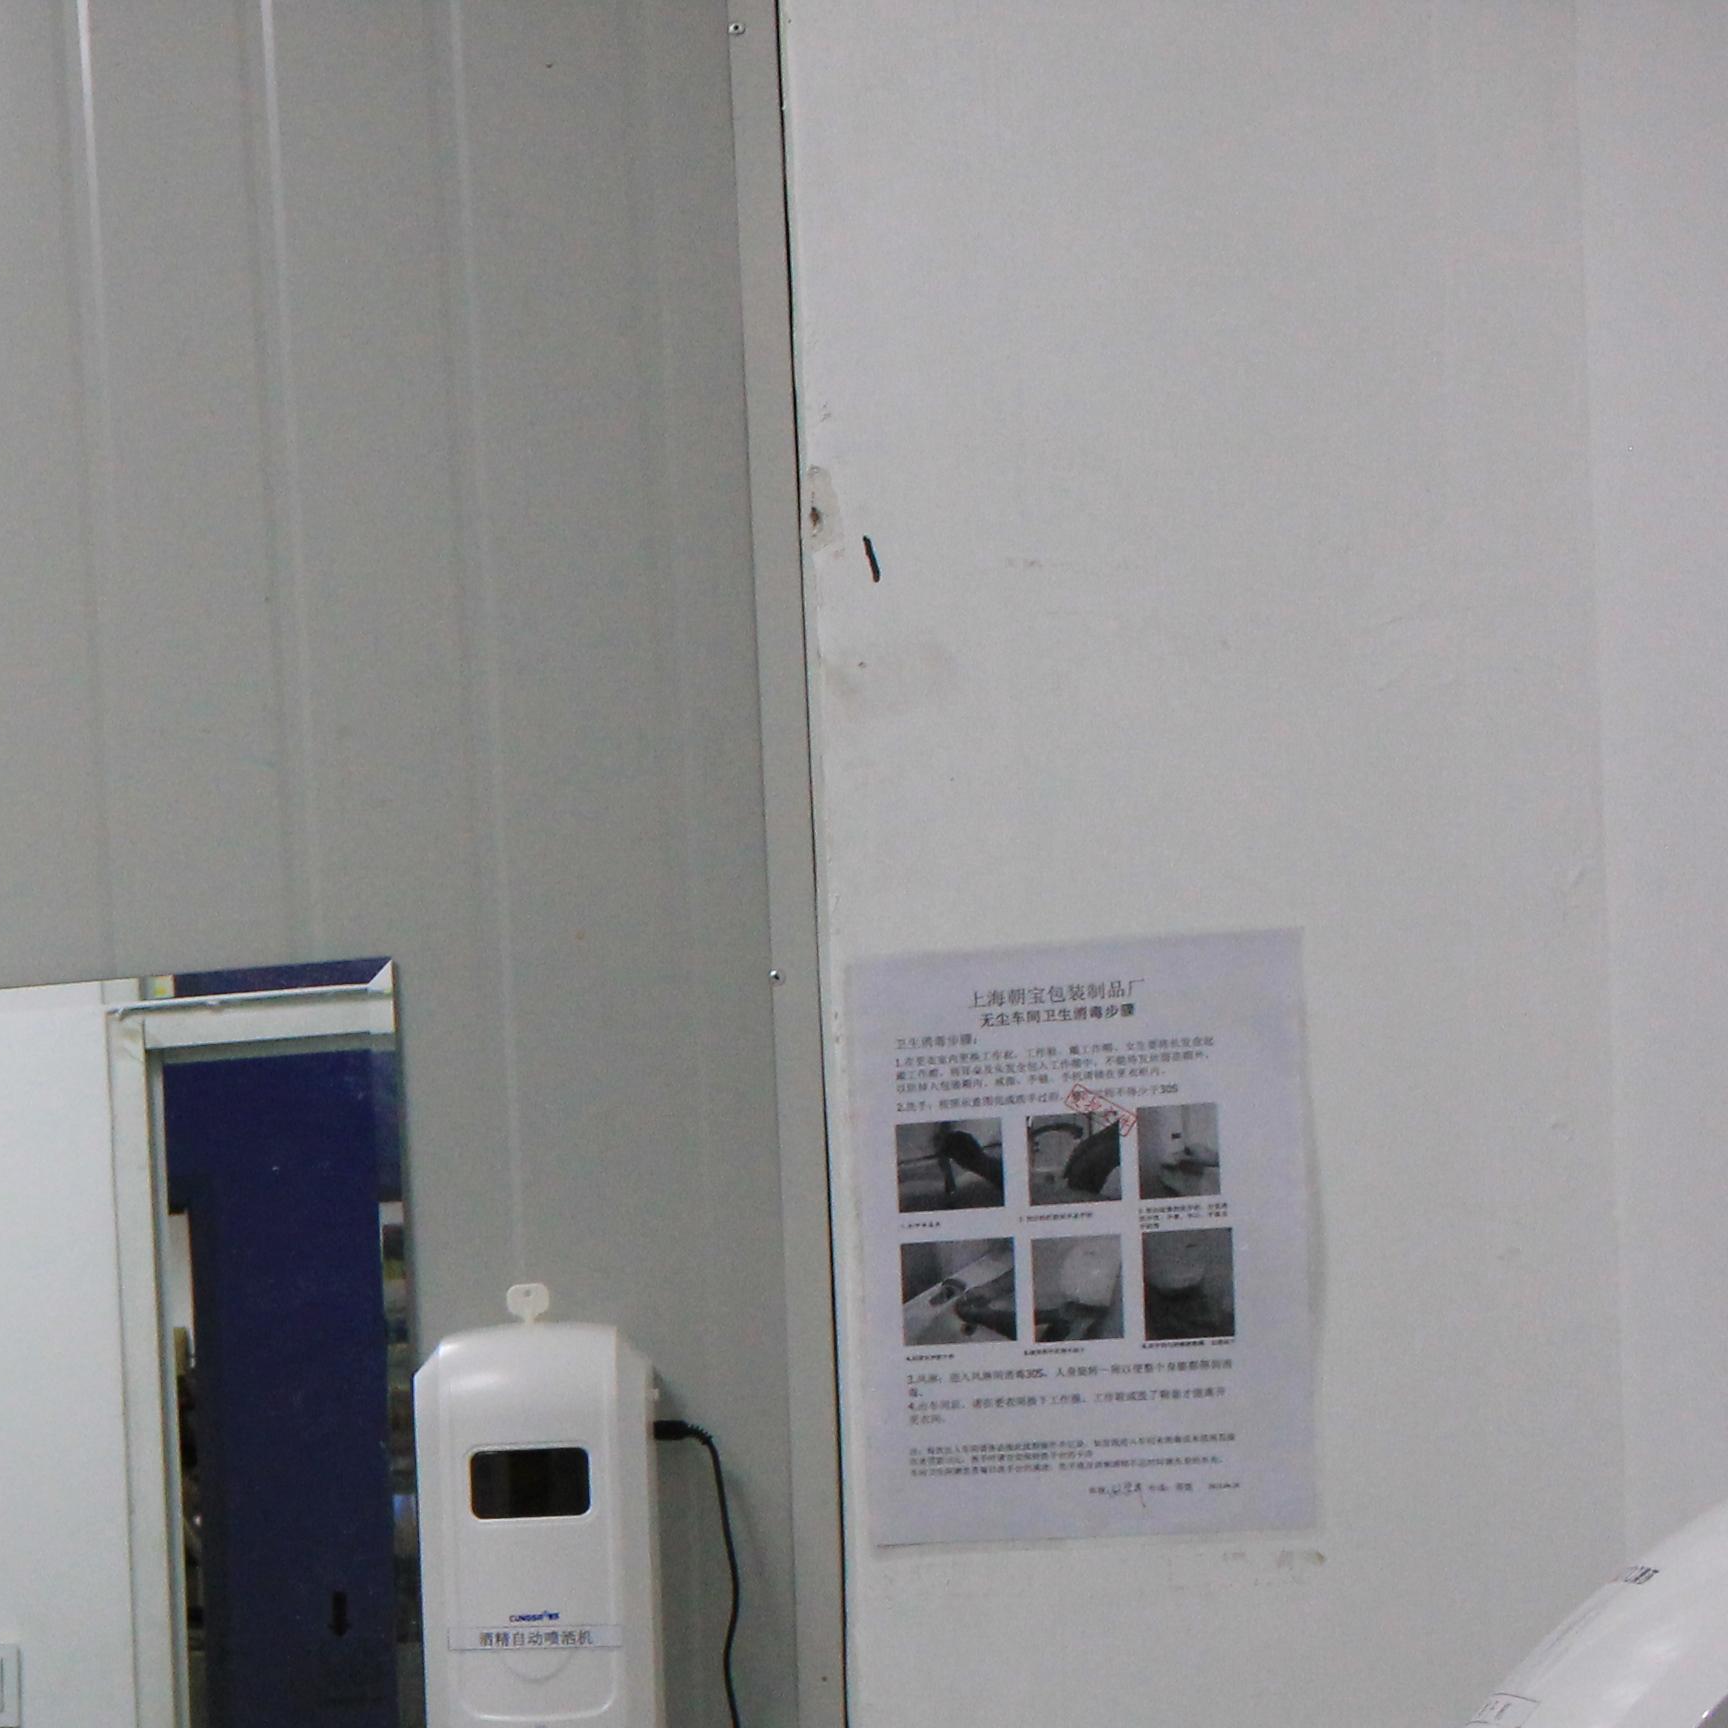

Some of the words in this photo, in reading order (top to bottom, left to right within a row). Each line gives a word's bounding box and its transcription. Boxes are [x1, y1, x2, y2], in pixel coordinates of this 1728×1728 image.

[981, 1003, 1135, 1028] 无尘车间卫生消毒步骤
[479, 1630, 593, 1647] 酒精自动喷洒机
